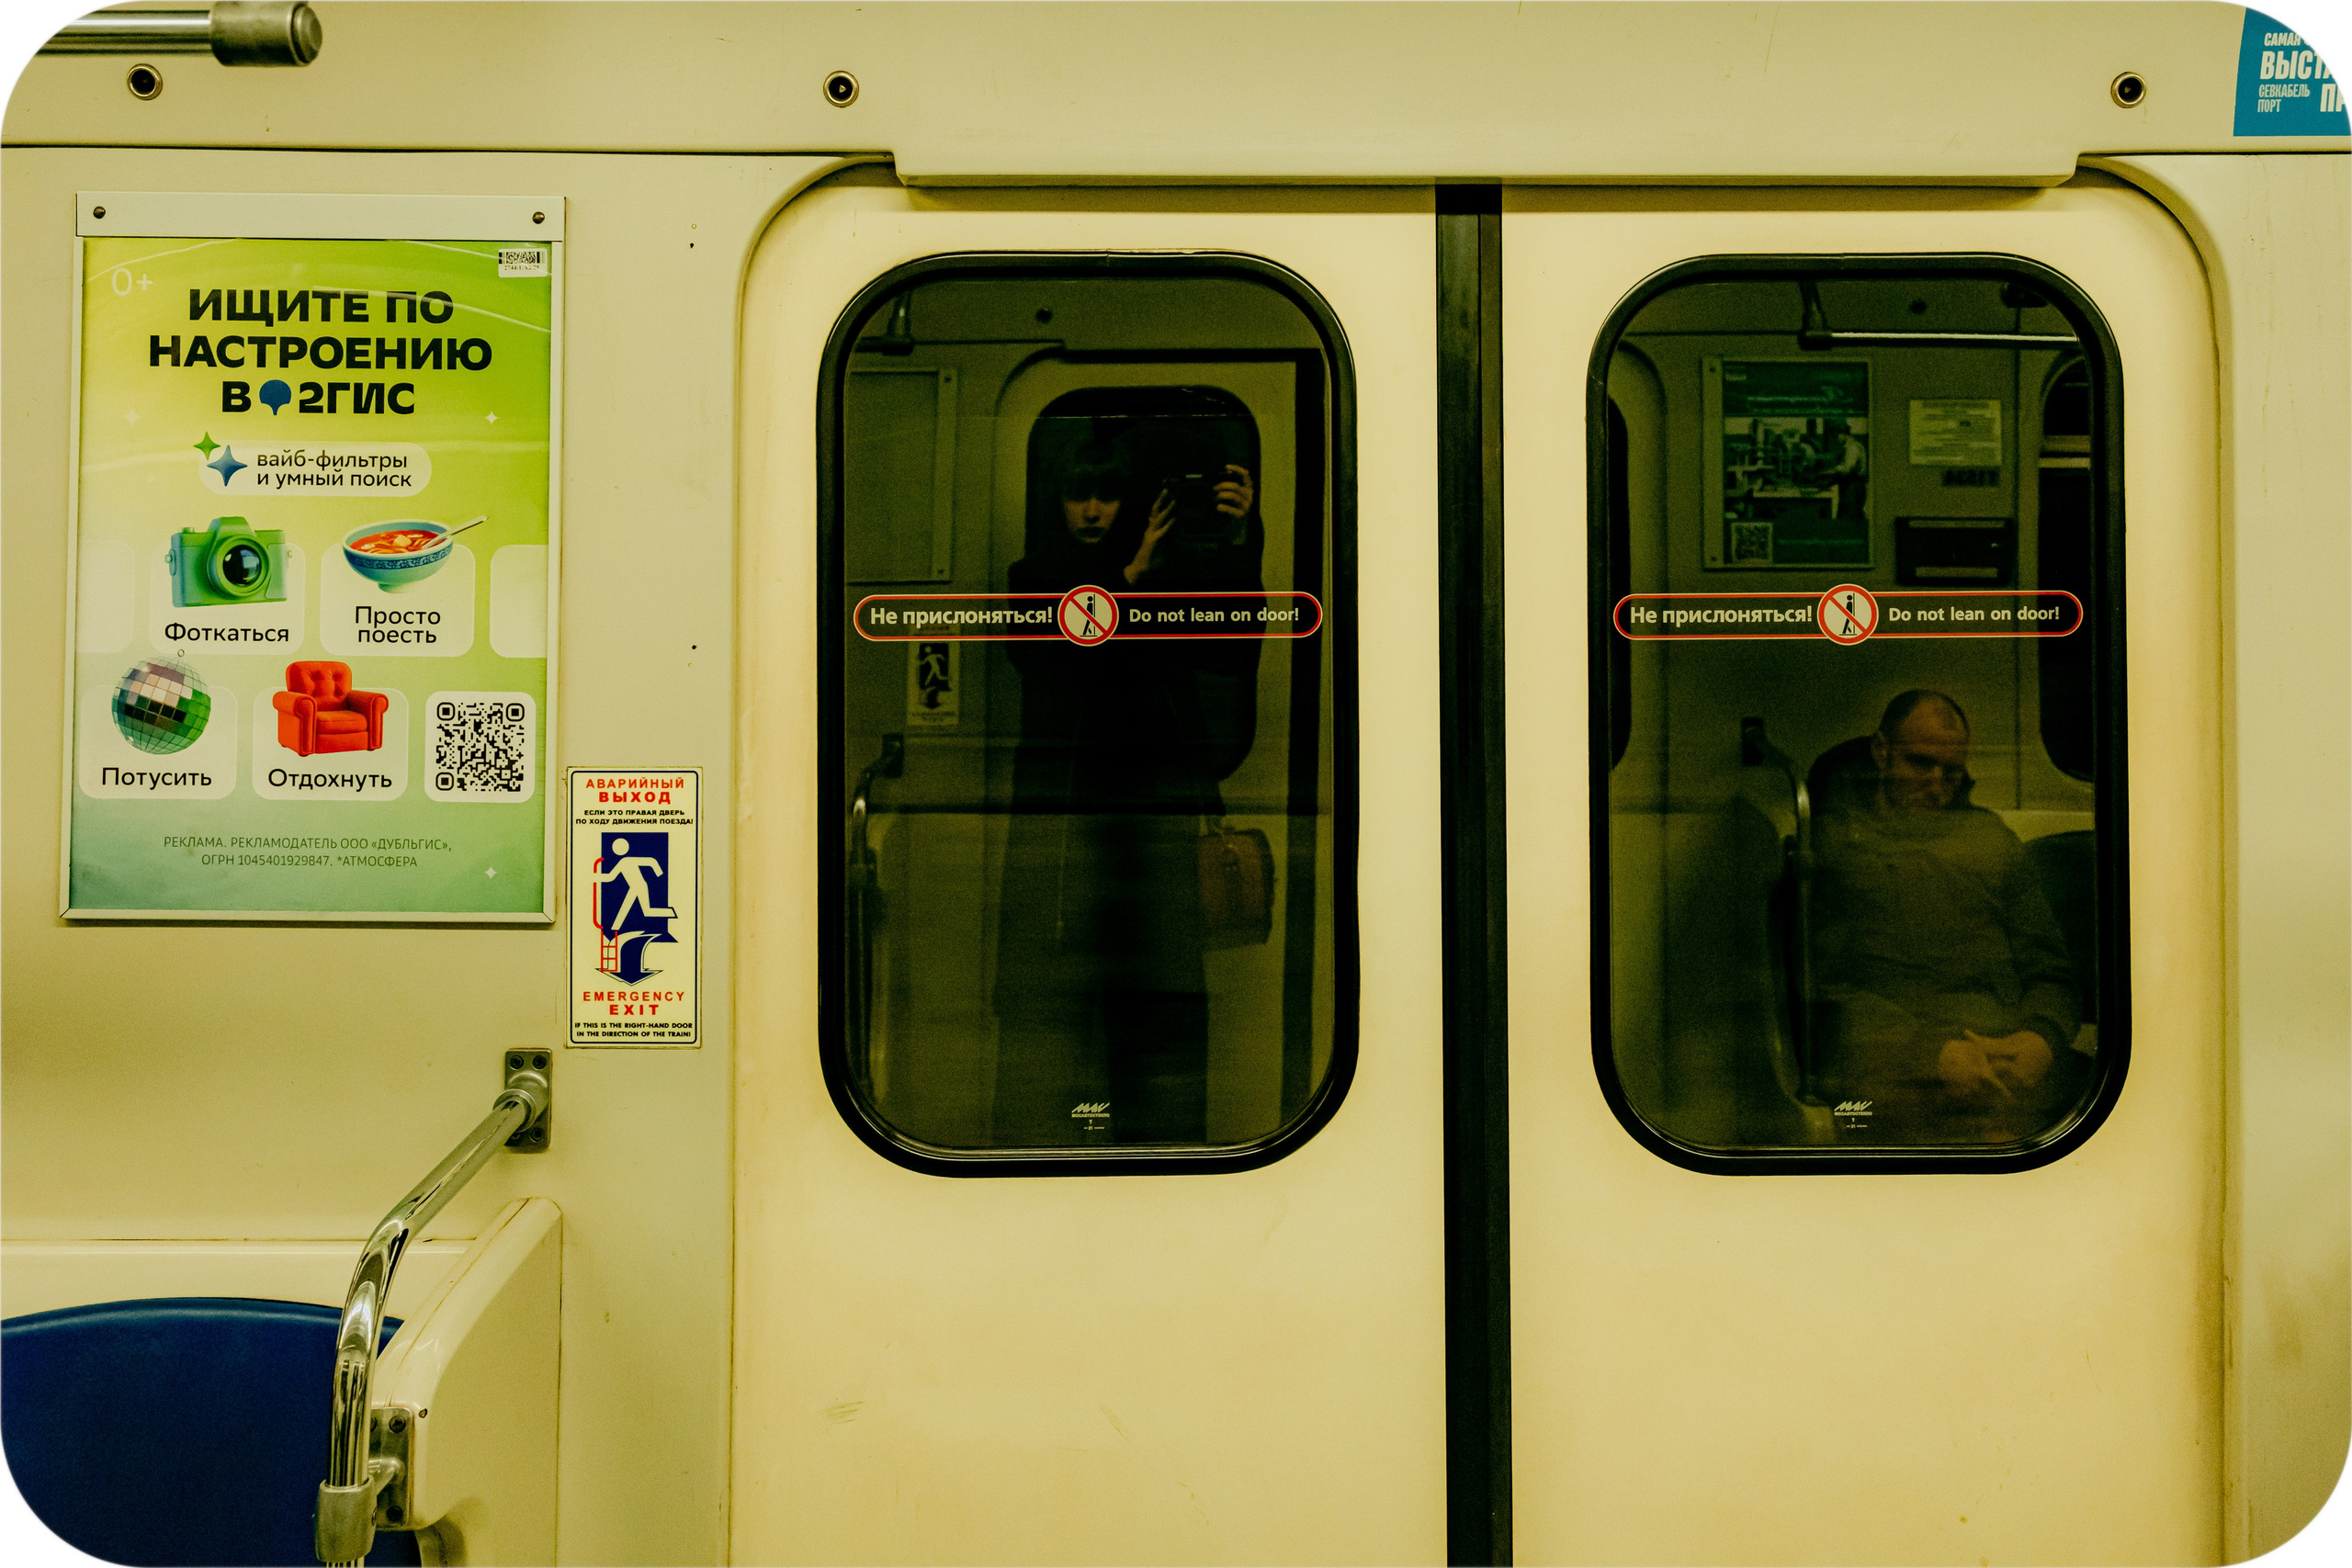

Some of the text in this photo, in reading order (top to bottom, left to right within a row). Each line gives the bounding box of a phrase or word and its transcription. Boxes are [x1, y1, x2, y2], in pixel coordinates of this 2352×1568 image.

[2264, 32, 2301, 46] САМАЯ
[2258, 84, 2311, 97] СЕВКАБЕЛЬ
[2257, 98, 2281, 112] ПОРТ
[111, 267, 153, 296] 0+
[189, 288, 454, 326] ИЩИТЕ ПО
[150, 334, 492, 370] НАСТРОЕНИЮ
[221, 381, 415, 414] В 2ГИС
[257, 449, 408, 470] вайб-фильтры
[257, 468, 412, 491] и умный поиск
[355, 606, 441, 627] Просто
[871, 605, 1053, 629] Не прислоняться!
[1129, 607, 1299, 623] Do not lean on door!
[1630, 605, 1813, 629] Не прислоняться!
[1889, 605, 2061, 622] Do not lean on door!
[164, 623, 289, 642] Фоткаться
[358, 626, 437, 644] поесть
[101, 767, 212, 790] Потусить
[267, 769, 392, 790] Отдохнуть
[585, 777, 684, 789] АВАРИЙНЫЙ
[598, 792, 671, 805] ВЫХОД
[164, 837, 452, 852] РЕКЛАМА. РЕКЛАМОДАТЕЛЬ ООО «ДУБЛЬГИС»,
[201, 854, 234, 865] ОГРН
[238, 855, 333, 866] 1045401929847.
[582, 991, 684, 1002] EMERGENCY
[609, 1004, 659, 1016] EXIT
